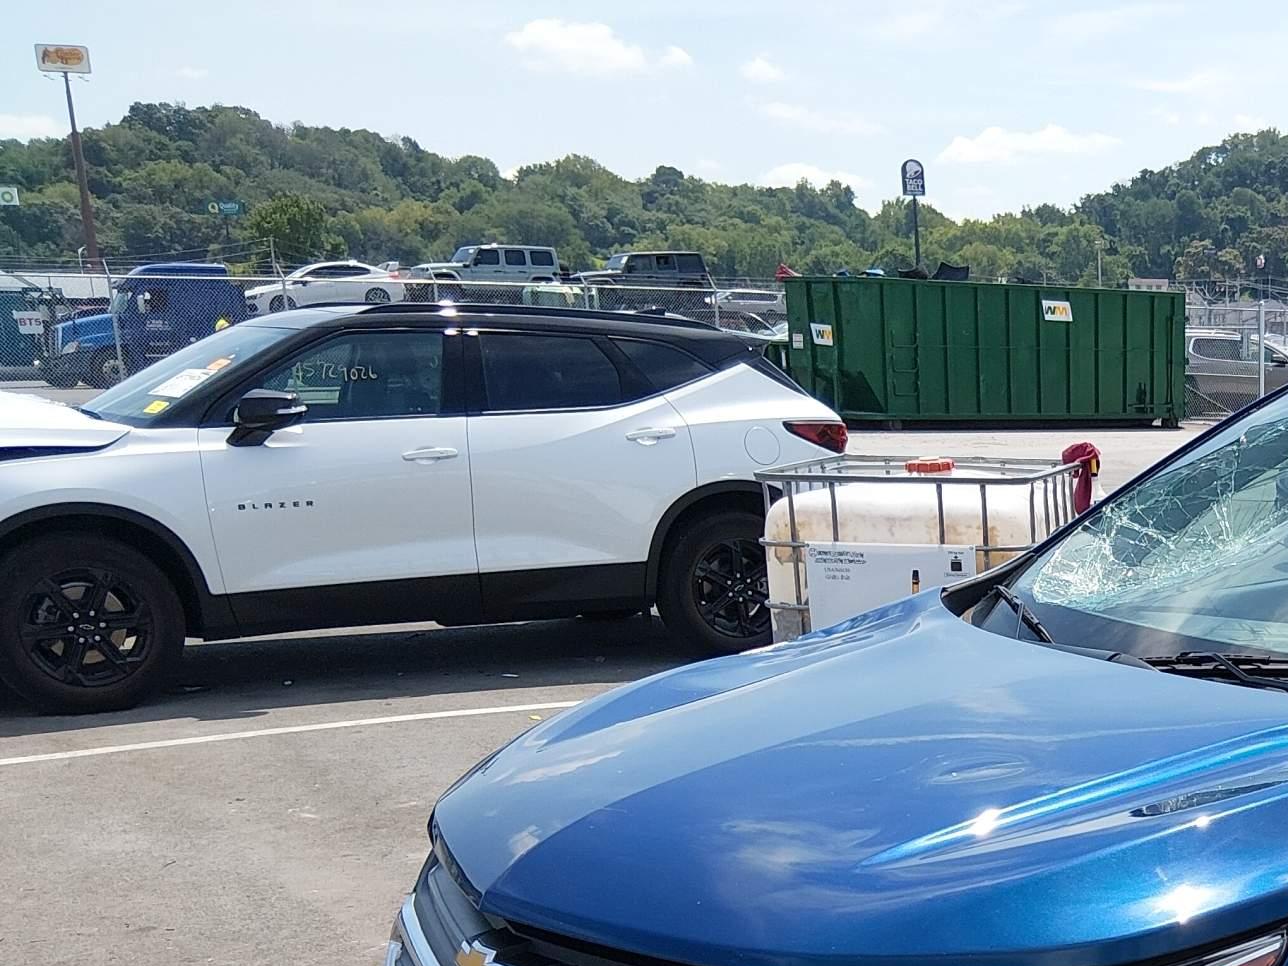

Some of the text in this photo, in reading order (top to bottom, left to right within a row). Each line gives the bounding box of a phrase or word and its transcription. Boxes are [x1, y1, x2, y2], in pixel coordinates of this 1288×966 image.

[1045, 305, 1067, 315] WM
[19, 318, 41, 326] BTS
[238, 500, 313, 510] BLAZER
